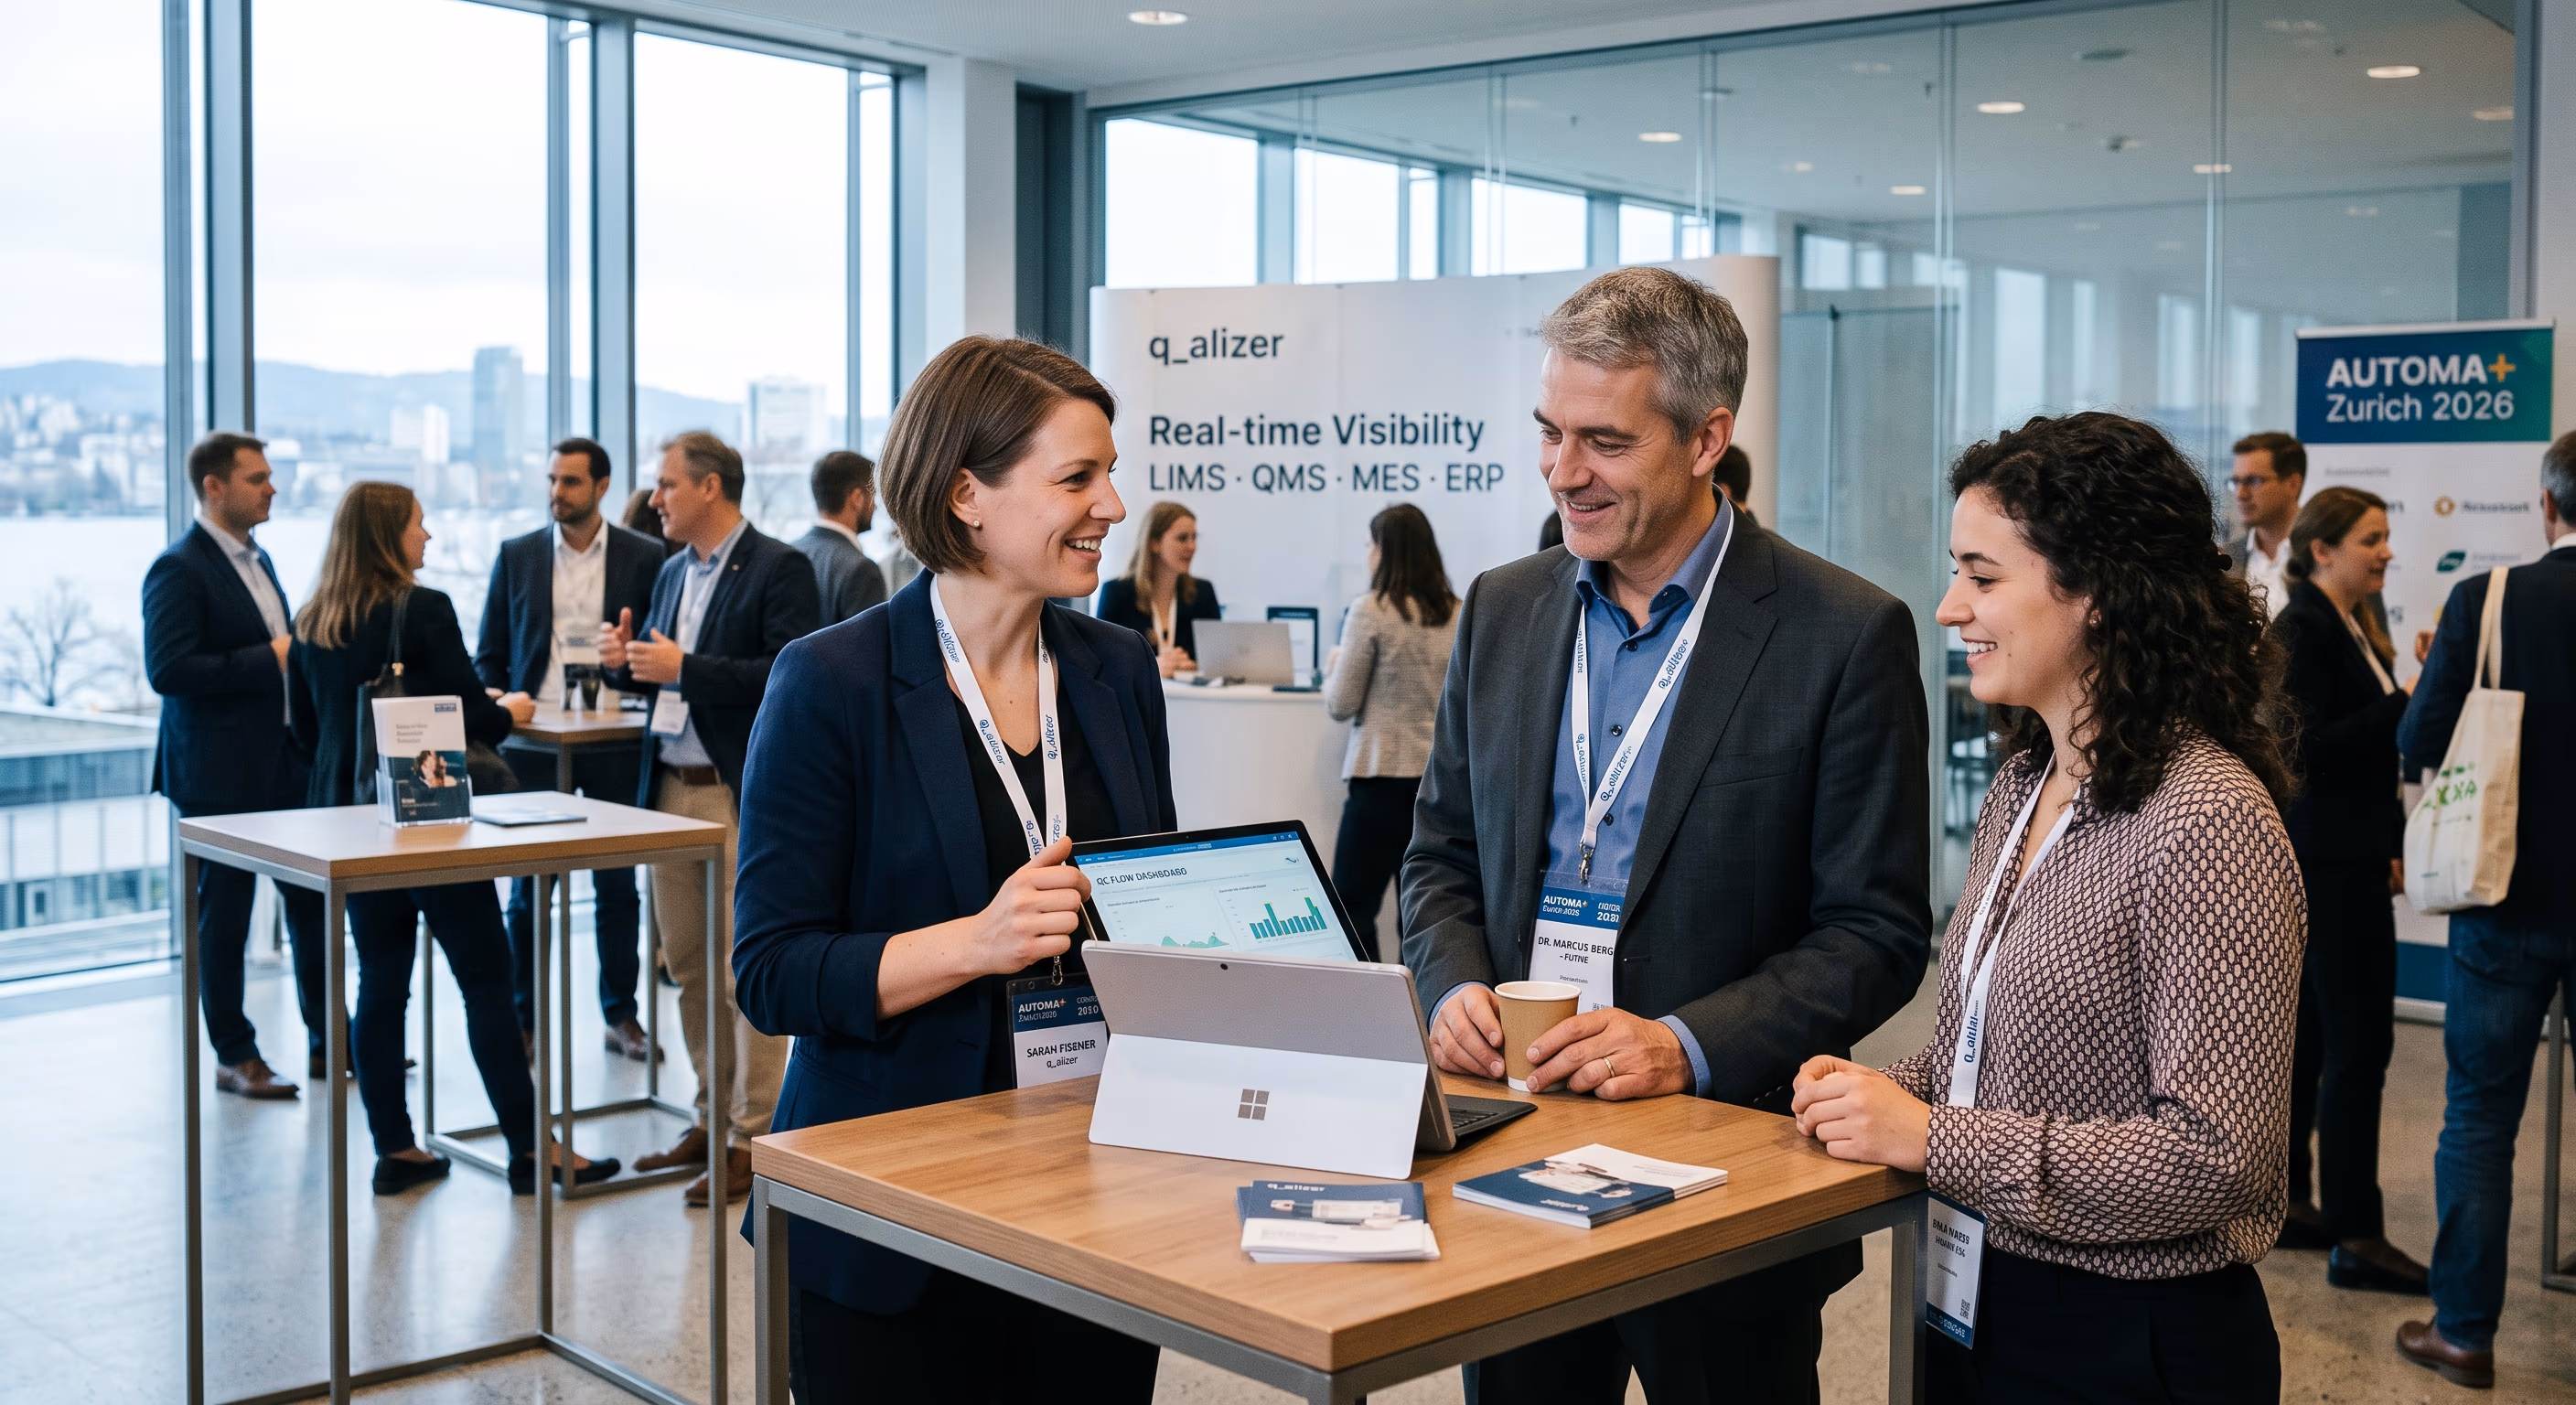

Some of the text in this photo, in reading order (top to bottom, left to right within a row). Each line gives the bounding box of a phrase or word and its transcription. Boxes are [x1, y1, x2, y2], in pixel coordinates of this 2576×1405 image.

[1149, 328, 1285, 365] q_alizer
[2325, 354, 2516, 388] AUTOMA+
[2325, 390, 2515, 423] Zurich 2026
[1150, 413, 1484, 453] Real-time Visibility
[1150, 464, 1227, 492] LIMS
[1251, 464, 1326, 494] QMS
[1352, 463, 1420, 491] MES
[1446, 463, 1504, 491] ERP
[1111, 874, 1134, 885] FLOW
[1538, 937, 1614, 956] DR. MARCUS BERG
